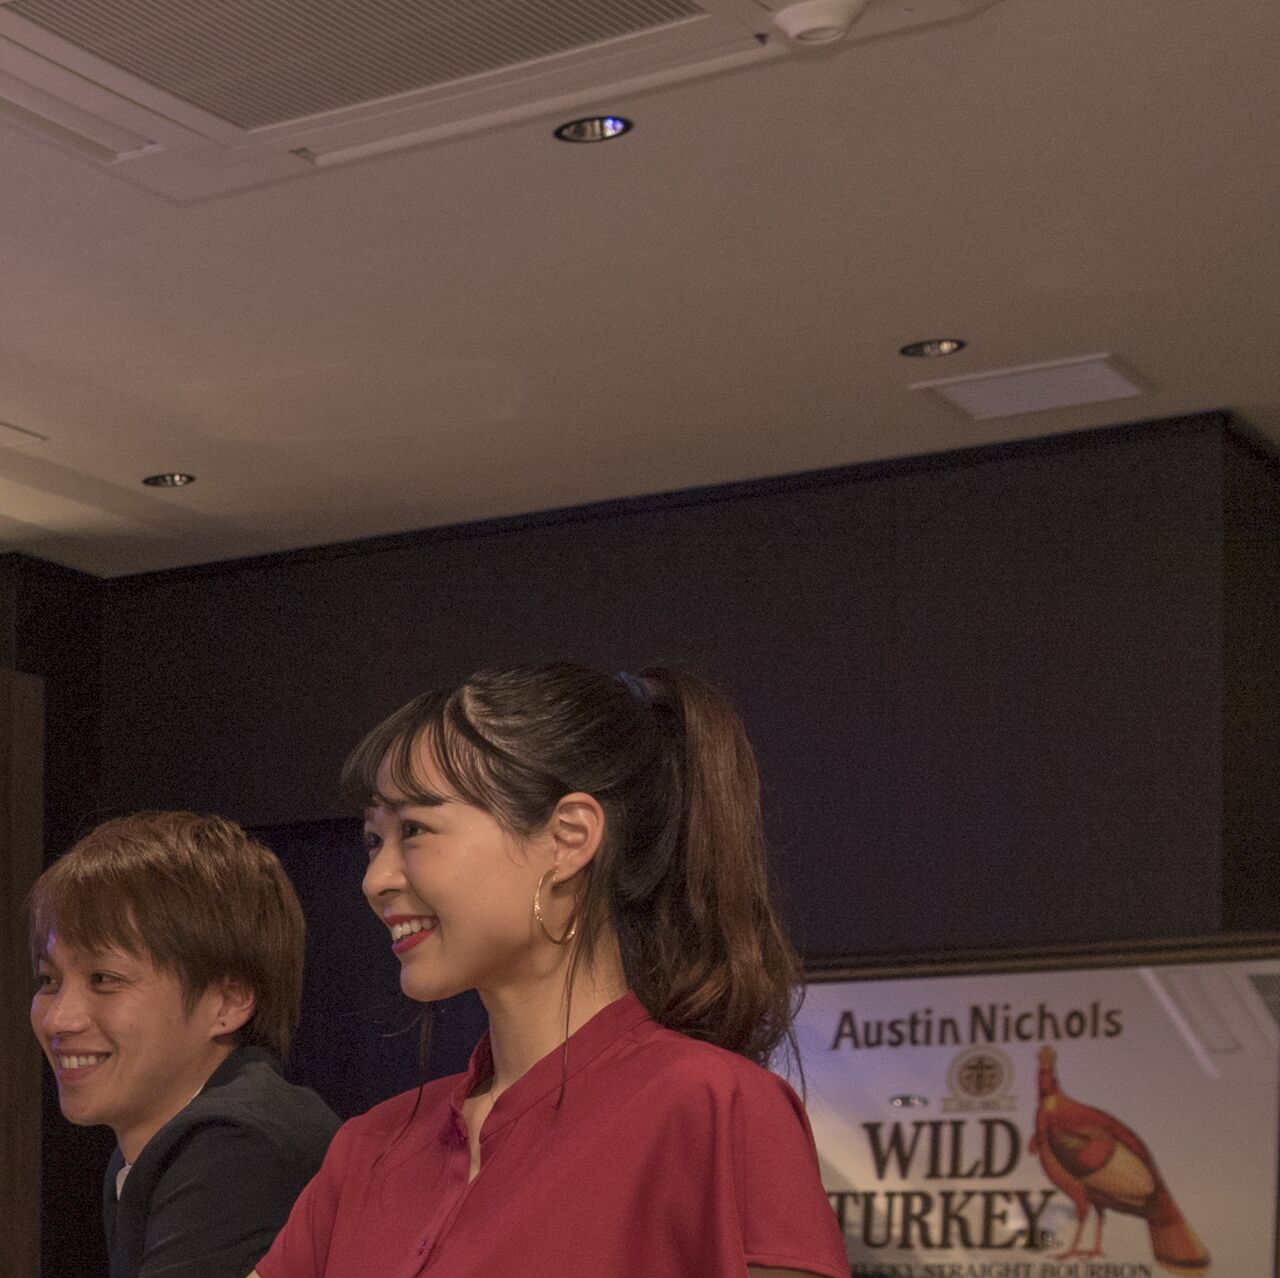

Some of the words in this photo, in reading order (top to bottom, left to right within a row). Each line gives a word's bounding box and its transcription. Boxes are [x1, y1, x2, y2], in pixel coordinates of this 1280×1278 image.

[832, 1008, 960, 1050] Austin
[970, 1000, 1124, 1047] Nichols
[863, 1117, 1021, 1180] WILD
[828, 1189, 1055, 1250] TURKEY
